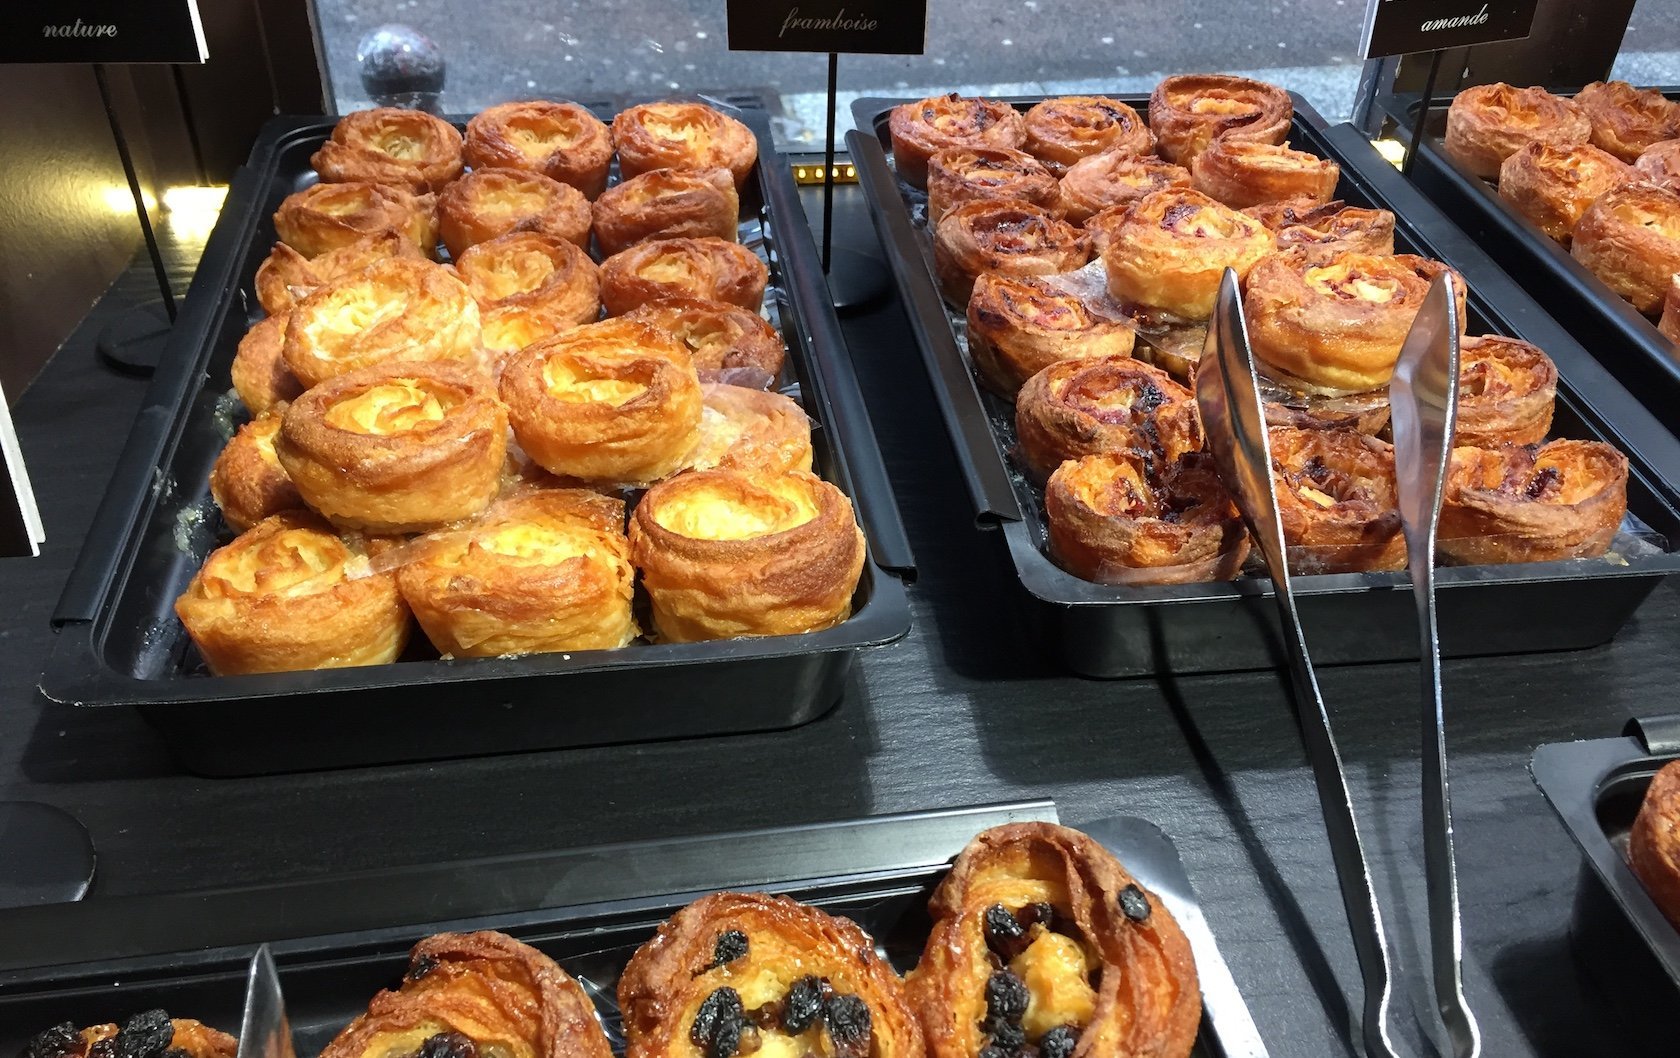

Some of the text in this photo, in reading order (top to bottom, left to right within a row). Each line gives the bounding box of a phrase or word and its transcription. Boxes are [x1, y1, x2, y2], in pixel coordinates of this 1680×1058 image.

[43, 18, 118, 38] nature
[778, 6, 879, 38] framboise
[1421, 3, 1489, 32] amande
